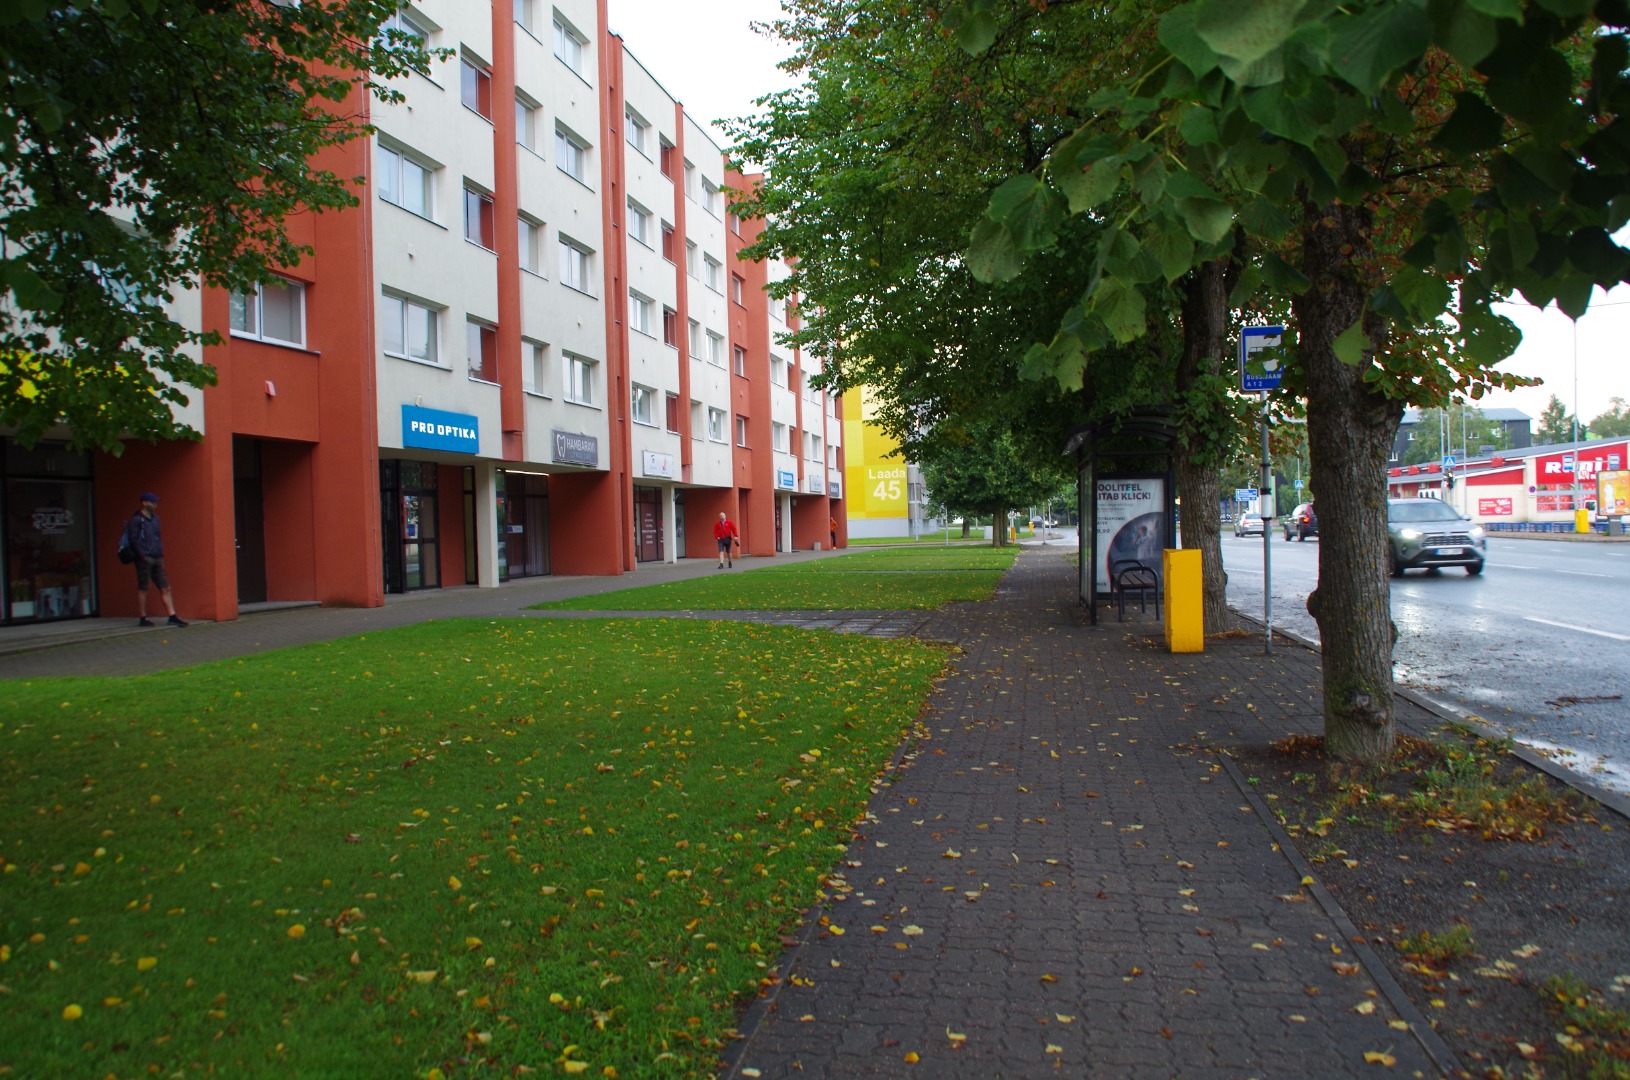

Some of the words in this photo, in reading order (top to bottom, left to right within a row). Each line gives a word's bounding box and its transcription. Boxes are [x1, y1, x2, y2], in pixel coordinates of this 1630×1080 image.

[411, 421, 434, 434] PRO
[437, 424, 476, 439] OPTIKA
[868, 467, 906, 479] Laada
[873, 480, 901, 501] 45
[1097, 483, 1142, 492] OOLITEEL
[1097, 492, 1119, 500] ITAB
[1121, 492, 1151, 500] KLICK!
